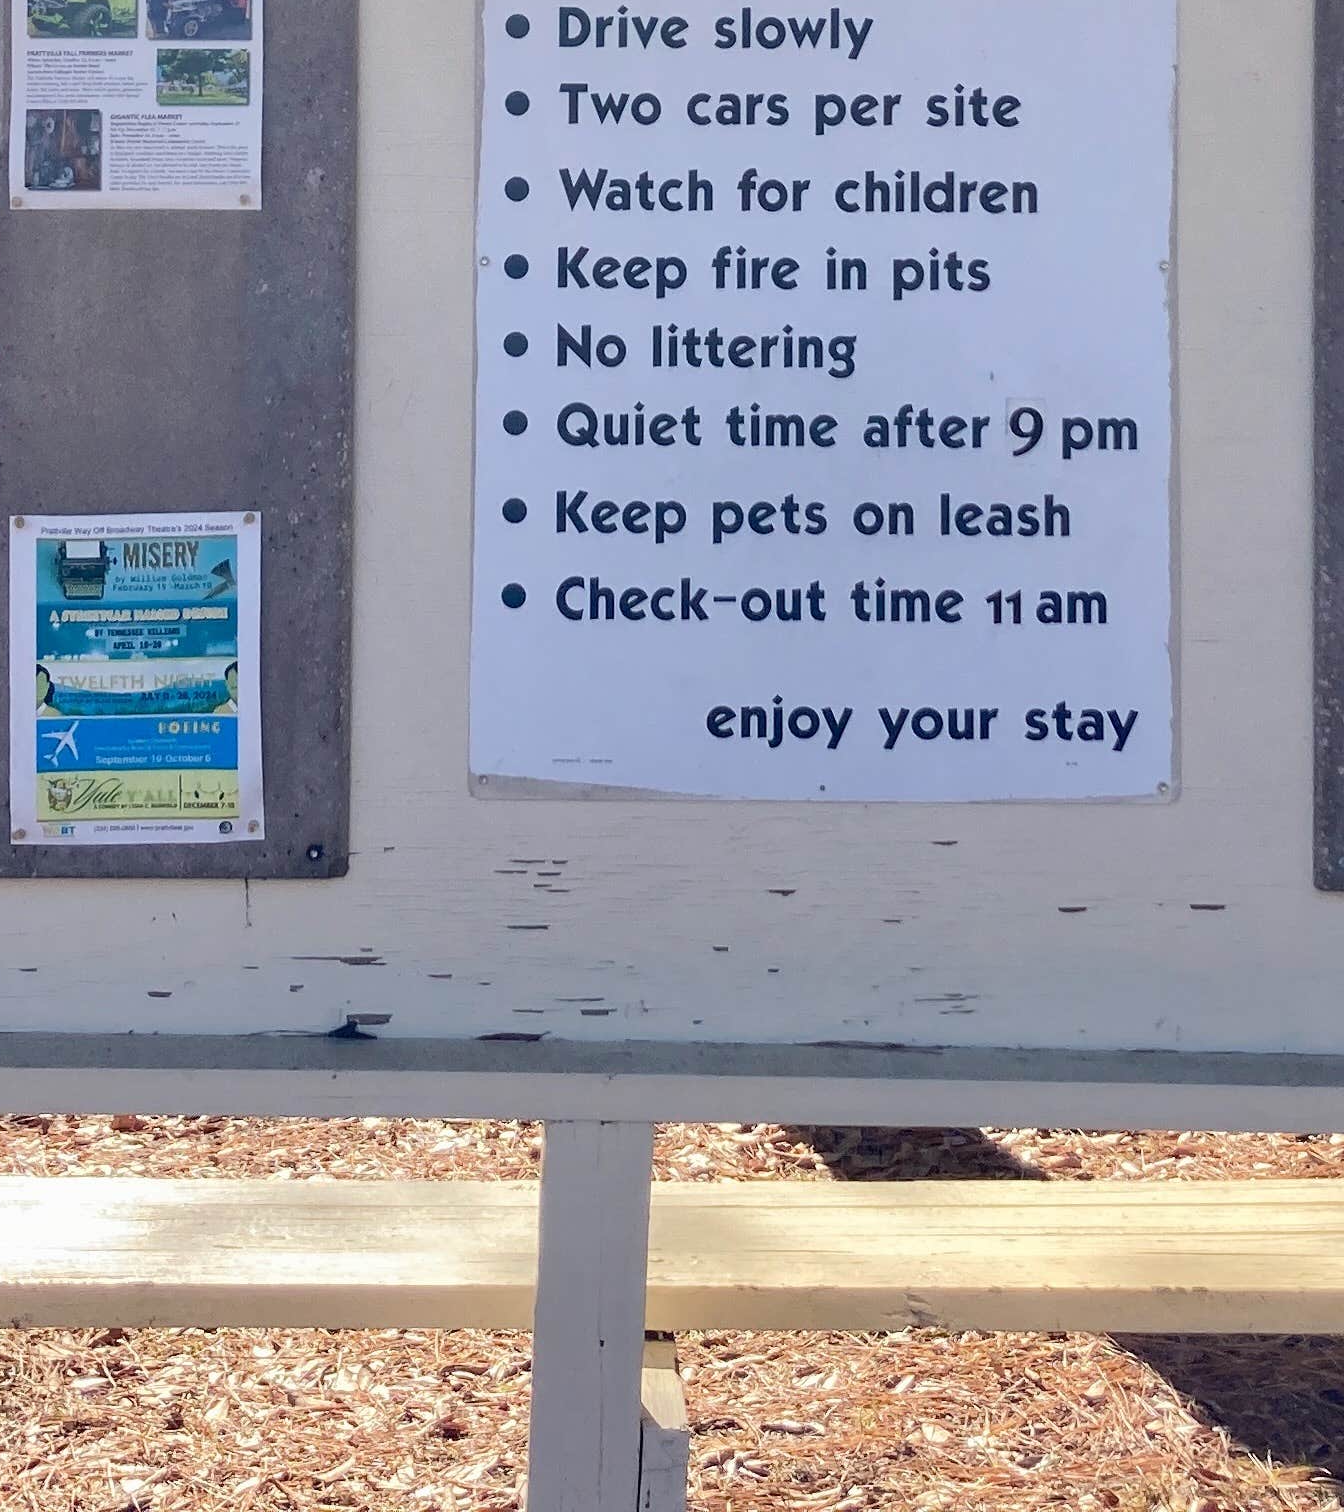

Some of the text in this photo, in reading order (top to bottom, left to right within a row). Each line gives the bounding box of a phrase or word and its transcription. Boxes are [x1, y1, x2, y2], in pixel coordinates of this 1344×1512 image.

[559, 6, 873, 59] Drive slowly
[560, 84, 1021, 135] Two cars per site
[559, 168, 1037, 214] Watch for children
[558, 246, 990, 300] Keep fire in pits
[557, 323, 856, 378] No littering
[557, 401, 1137, 460] Quiet time after 9 pm
[74, 527, 91, 536] Way
[107, 526, 144, 535] Broadway
[184, 524, 203, 533] 2024
[205, 523, 233, 532] Season
[557, 491, 1070, 544] Keep pets on leash
[123, 541, 199, 570] MISERY
[113, 583, 153, 593] February
[556, 576, 1107, 624] Check-out time 11 am
[50, 610, 60, 622] A
[113, 640, 135, 649] APRIL
[57, 672, 217, 689] TWELFTH NIGHT
[158, 721, 221, 735] BOEING
[707, 694, 1138, 752] enjoy your stay
[96, 755, 148, 765] September
[165, 753, 203, 763] October
[64, 778, 178, 813] Yule Y'ALL
